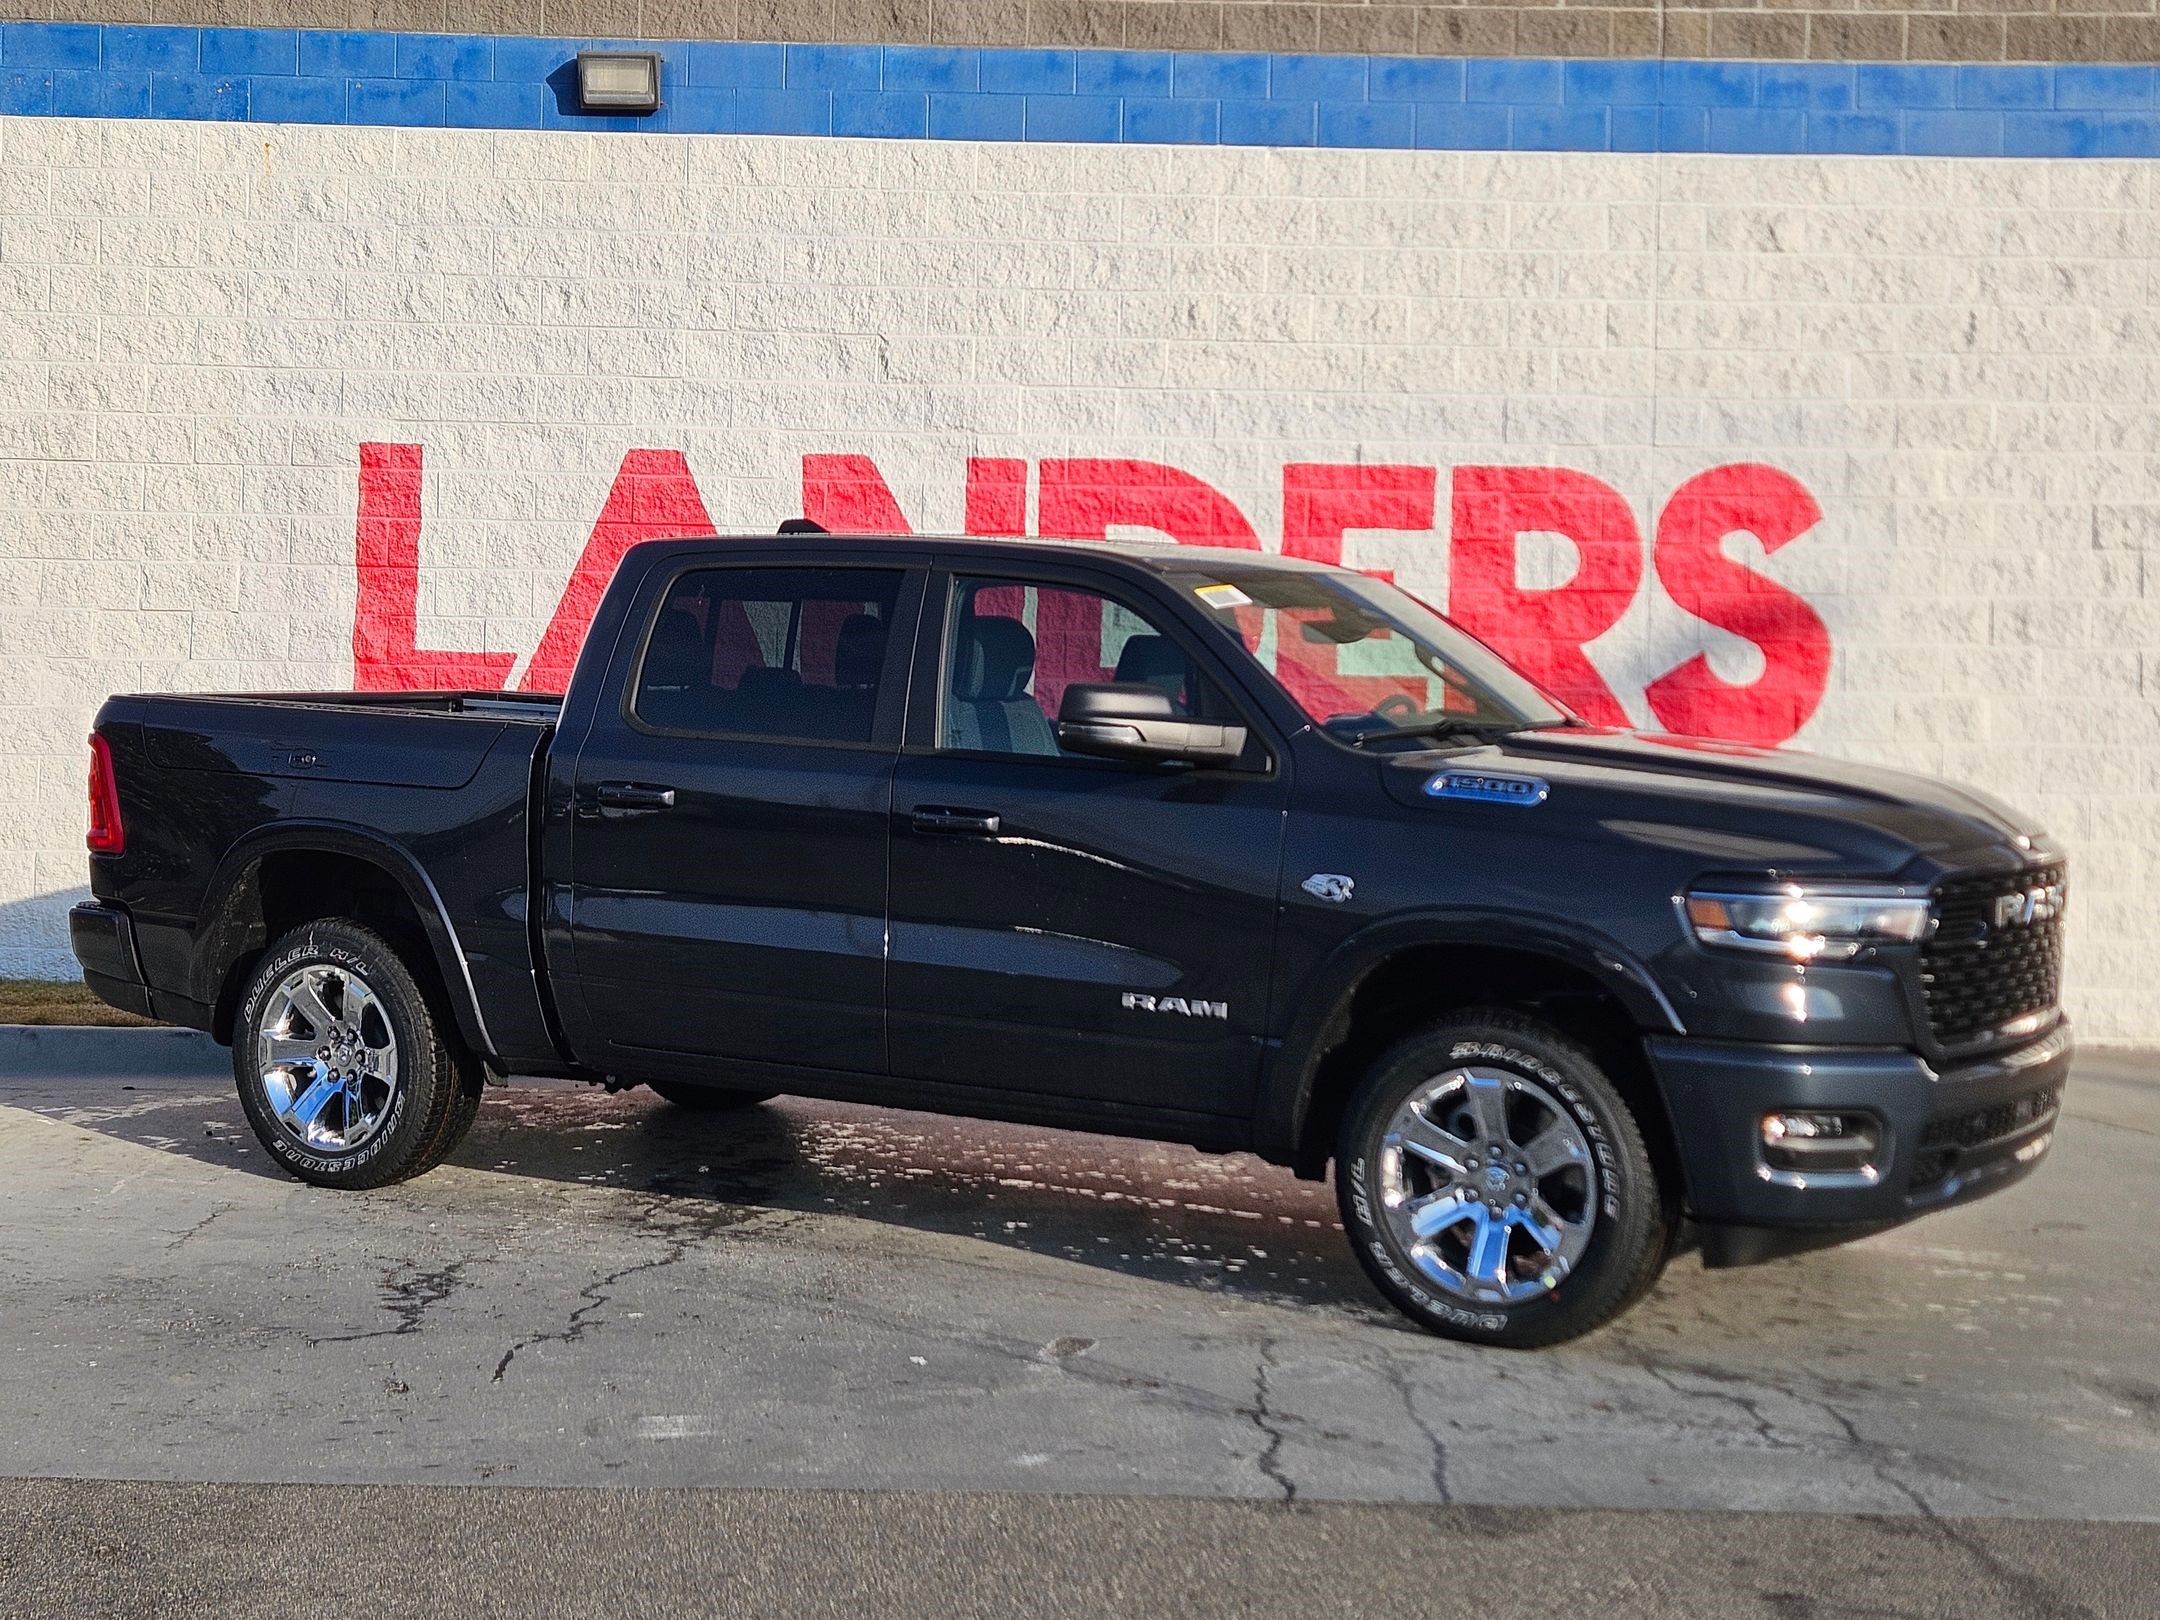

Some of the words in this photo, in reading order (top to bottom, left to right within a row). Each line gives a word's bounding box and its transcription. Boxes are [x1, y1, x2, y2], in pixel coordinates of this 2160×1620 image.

[243, 944, 320, 1024] DUELER
[1121, 992, 1229, 1021] RAM
[272, 1089, 406, 1173] BRIDGESTONE
